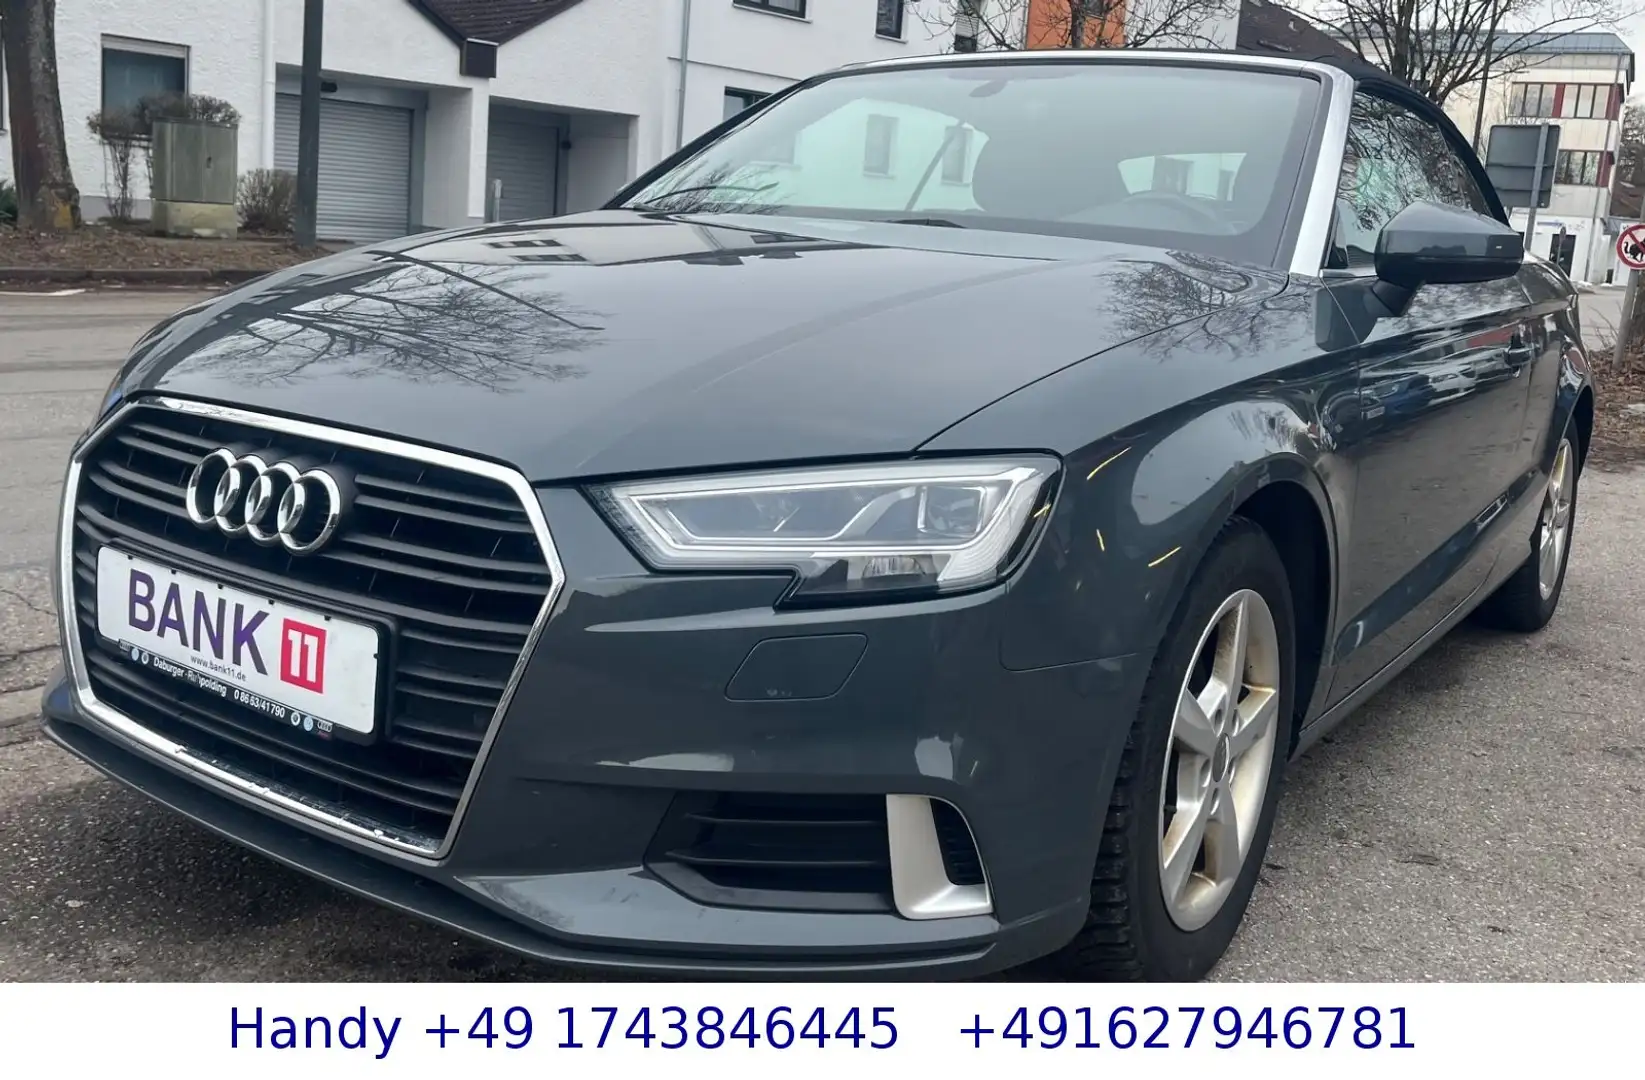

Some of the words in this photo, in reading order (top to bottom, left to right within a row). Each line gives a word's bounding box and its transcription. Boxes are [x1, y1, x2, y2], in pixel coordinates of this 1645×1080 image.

[128, 568, 270, 676] BANK
[286, 628, 319, 684] 11
[153, 656, 185, 677] Daburger
[190, 655, 247, 682] www.bank11.de
